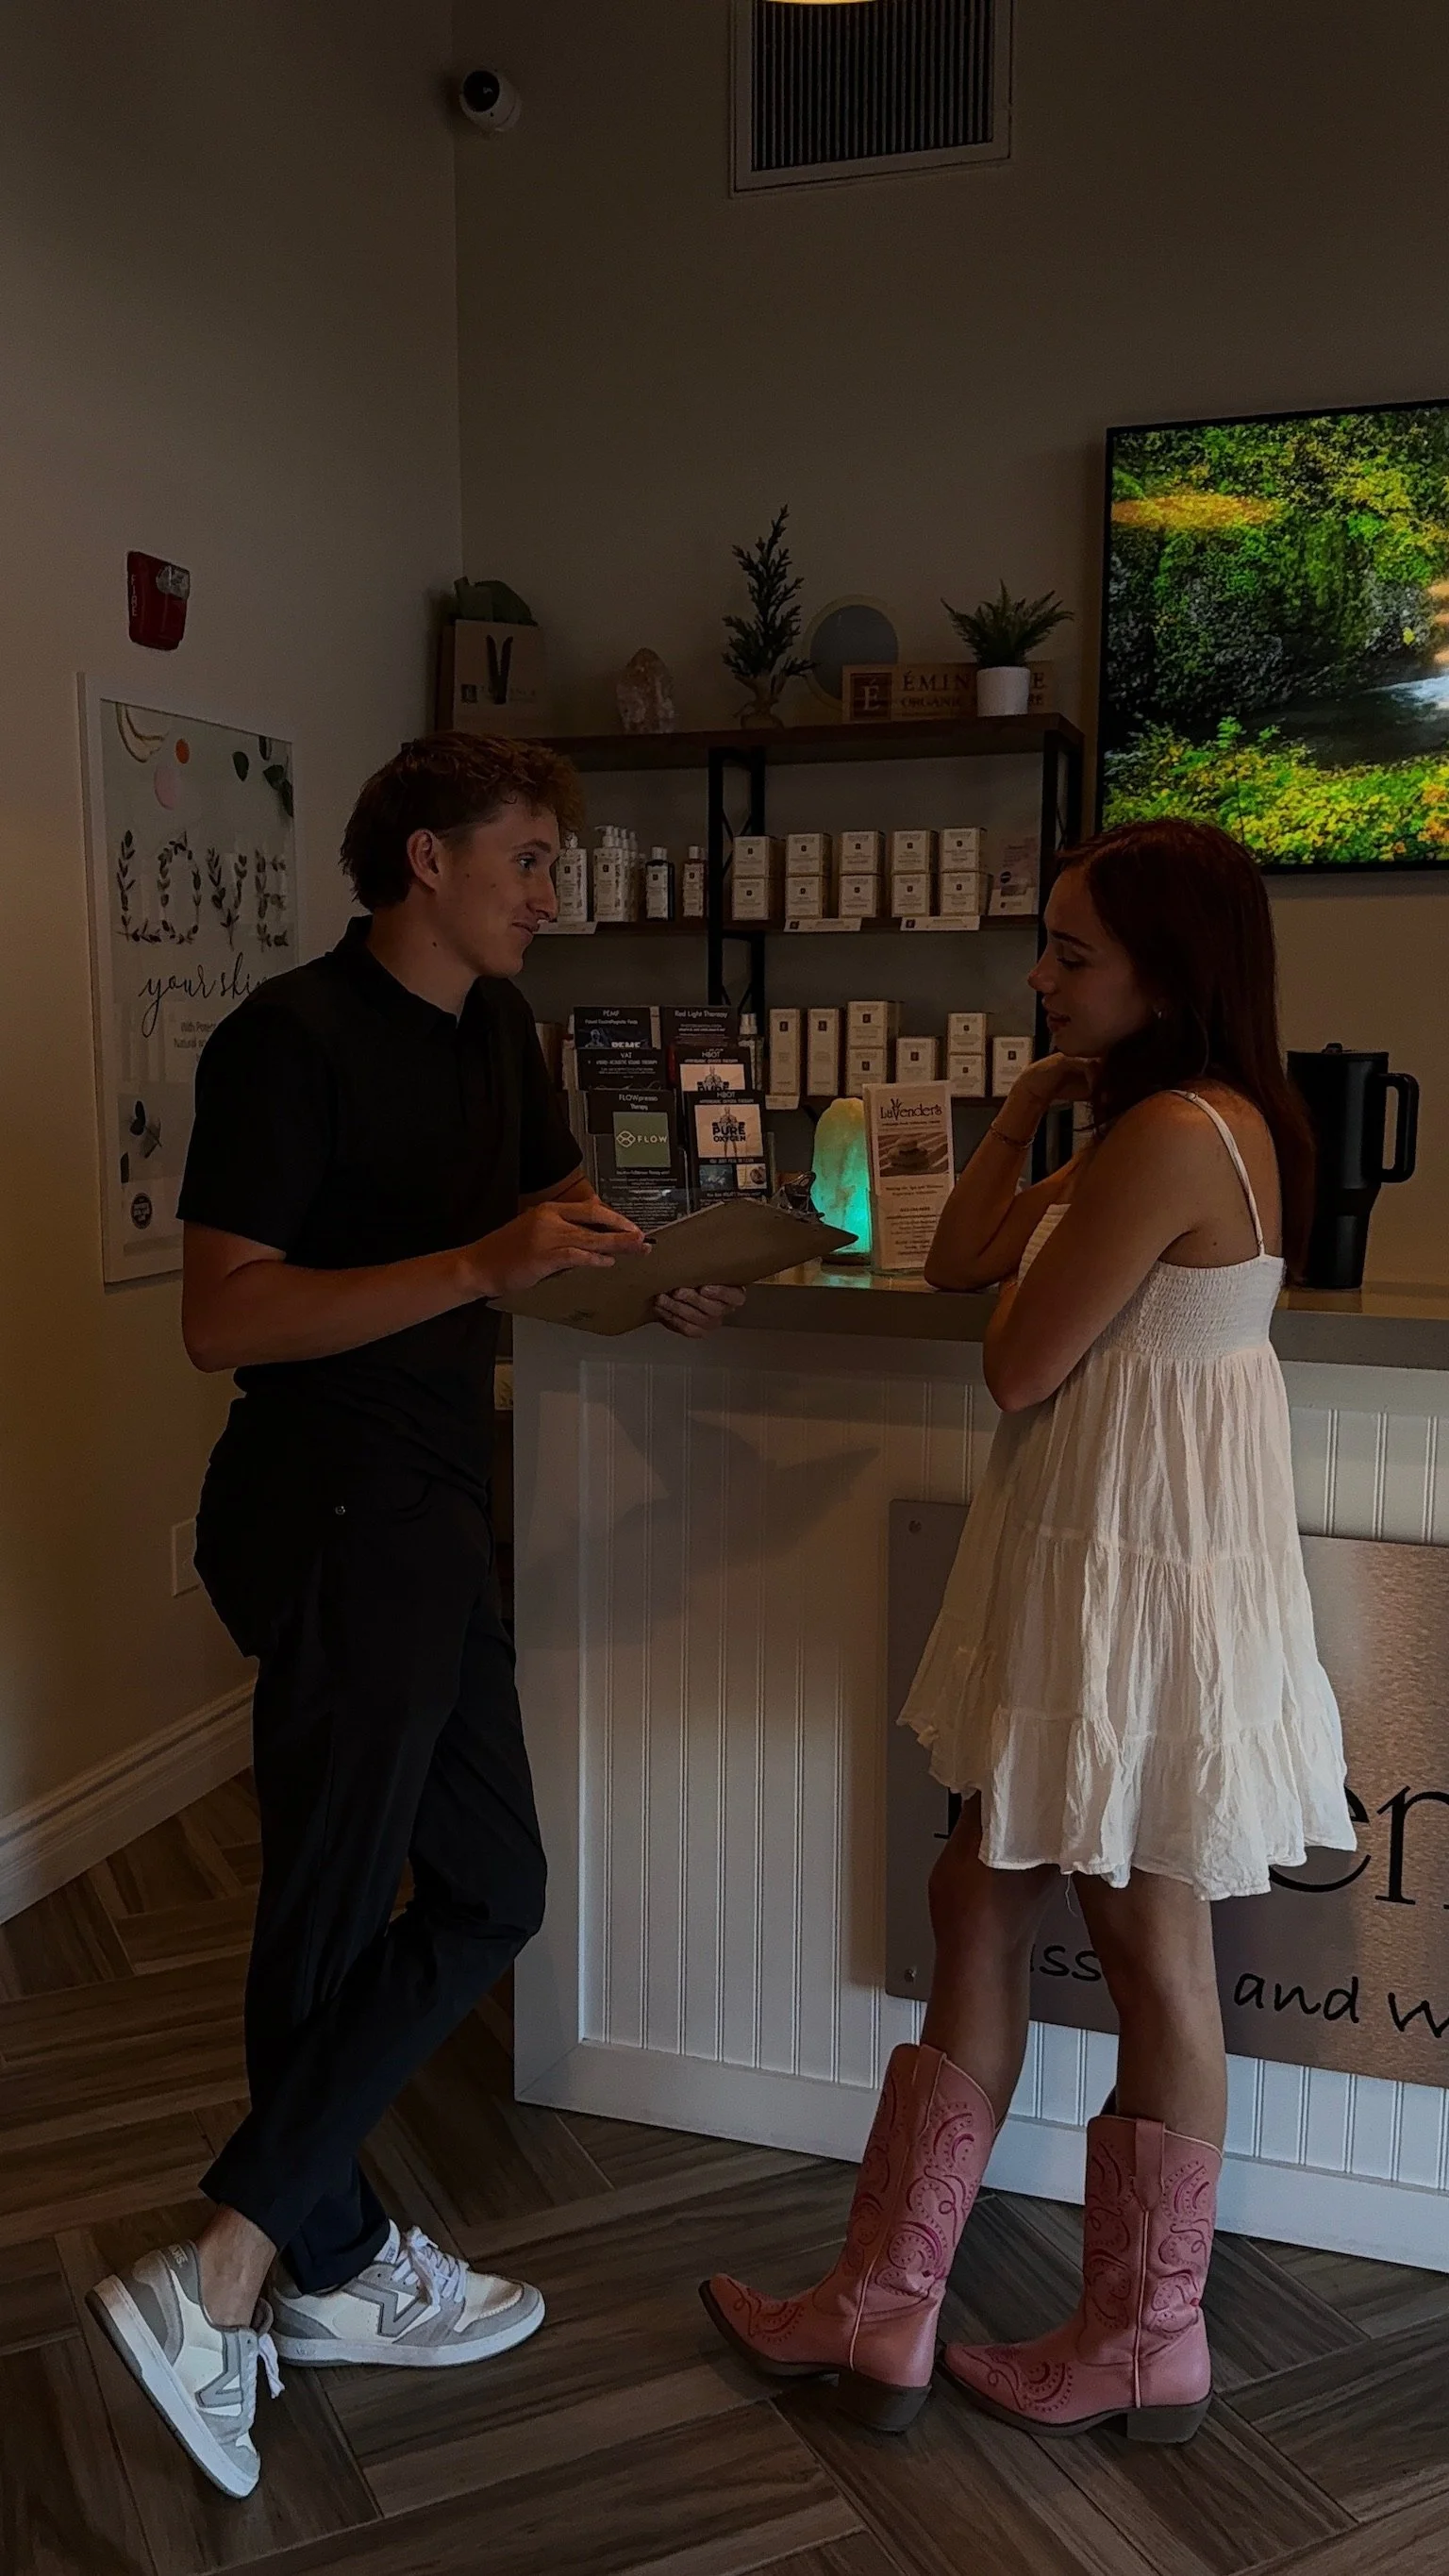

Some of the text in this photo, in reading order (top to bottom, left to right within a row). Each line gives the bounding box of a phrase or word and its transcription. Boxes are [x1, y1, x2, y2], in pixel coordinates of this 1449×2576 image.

[116, 829, 290, 951] LOVE
[139, 951, 269, 1038] your ski
[637, 1134, 668, 1144] FLOW
[712, 1123, 746, 1135] PURE
[1234, 1973, 1359, 2023] and
